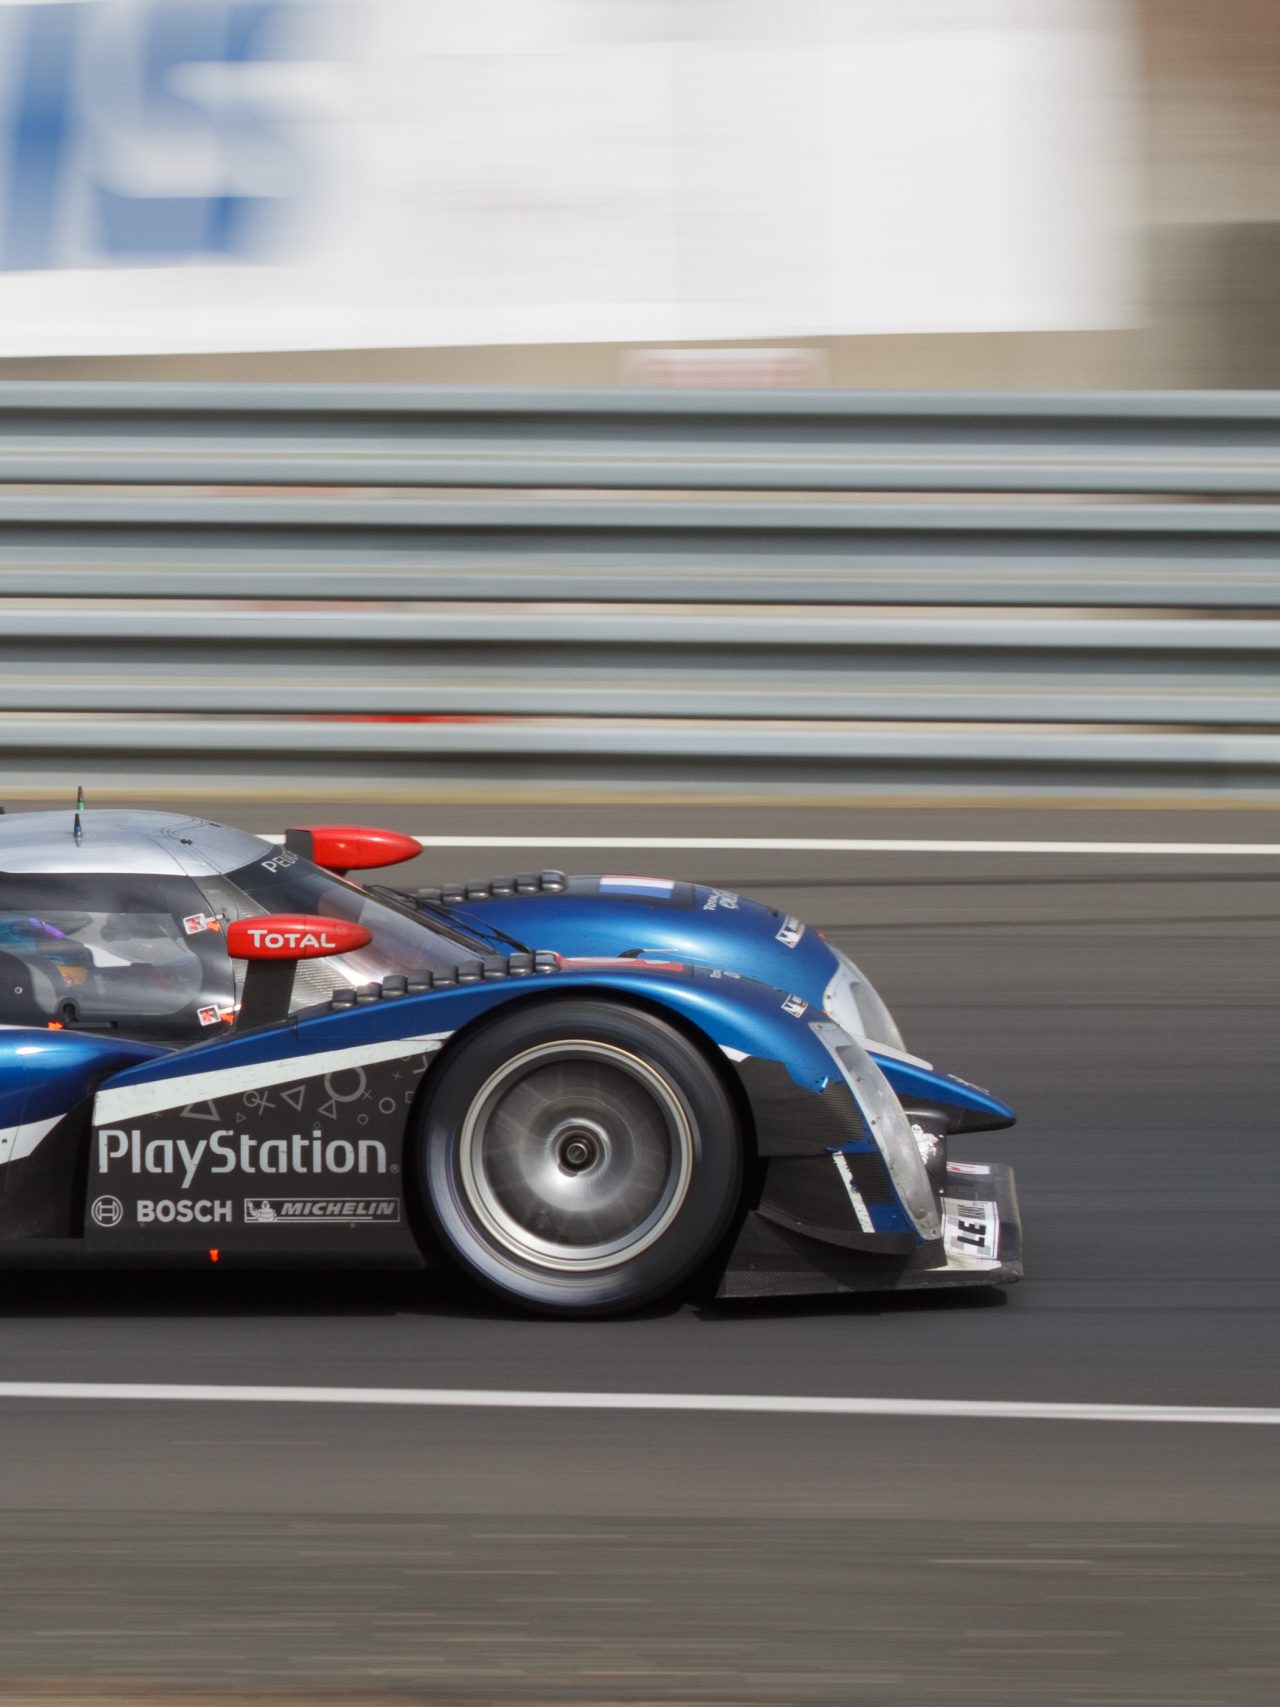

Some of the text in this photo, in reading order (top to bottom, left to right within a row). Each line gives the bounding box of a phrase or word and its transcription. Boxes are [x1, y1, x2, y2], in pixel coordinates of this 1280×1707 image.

[247, 929, 336, 949] TOTAL
[98, 1130, 387, 1189] PlayStation
[136, 1200, 233, 1223] BOSCH
[280, 1202, 396, 1216] MICHELIN
